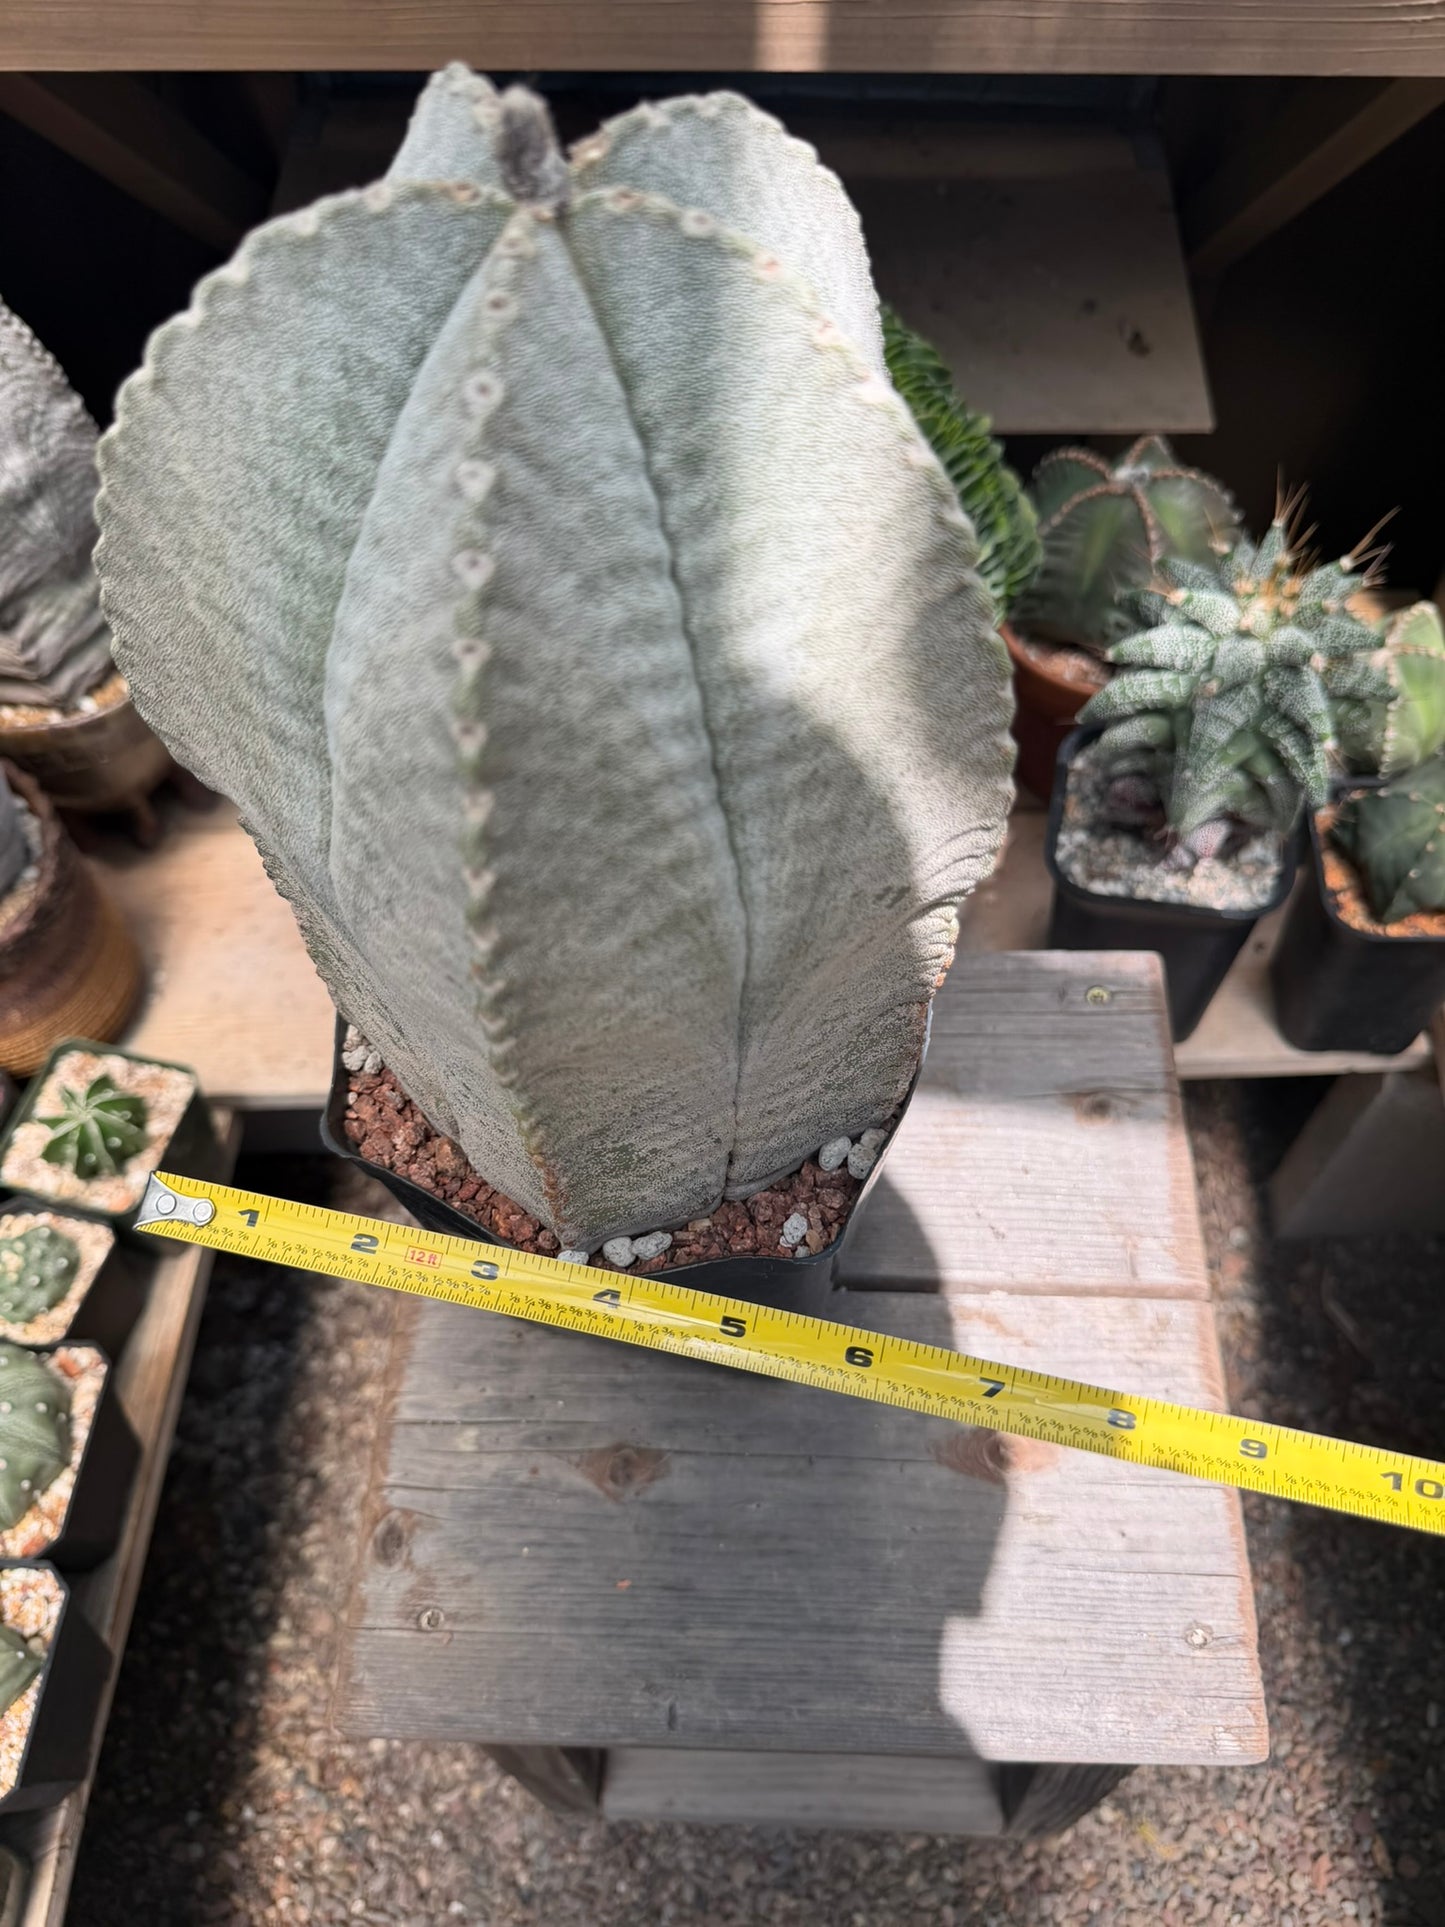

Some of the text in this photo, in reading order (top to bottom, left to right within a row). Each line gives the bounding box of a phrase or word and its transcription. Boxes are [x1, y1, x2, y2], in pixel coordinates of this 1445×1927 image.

[409, 1250, 438, 1265] 12 ft
[510, 1292, 614, 1323] 1/8 1/4 3/8 1/2 5/8 3/4 7/8
[238, 1209, 1444, 1499] 1 2 3 4 5 6 7 8 9 10
